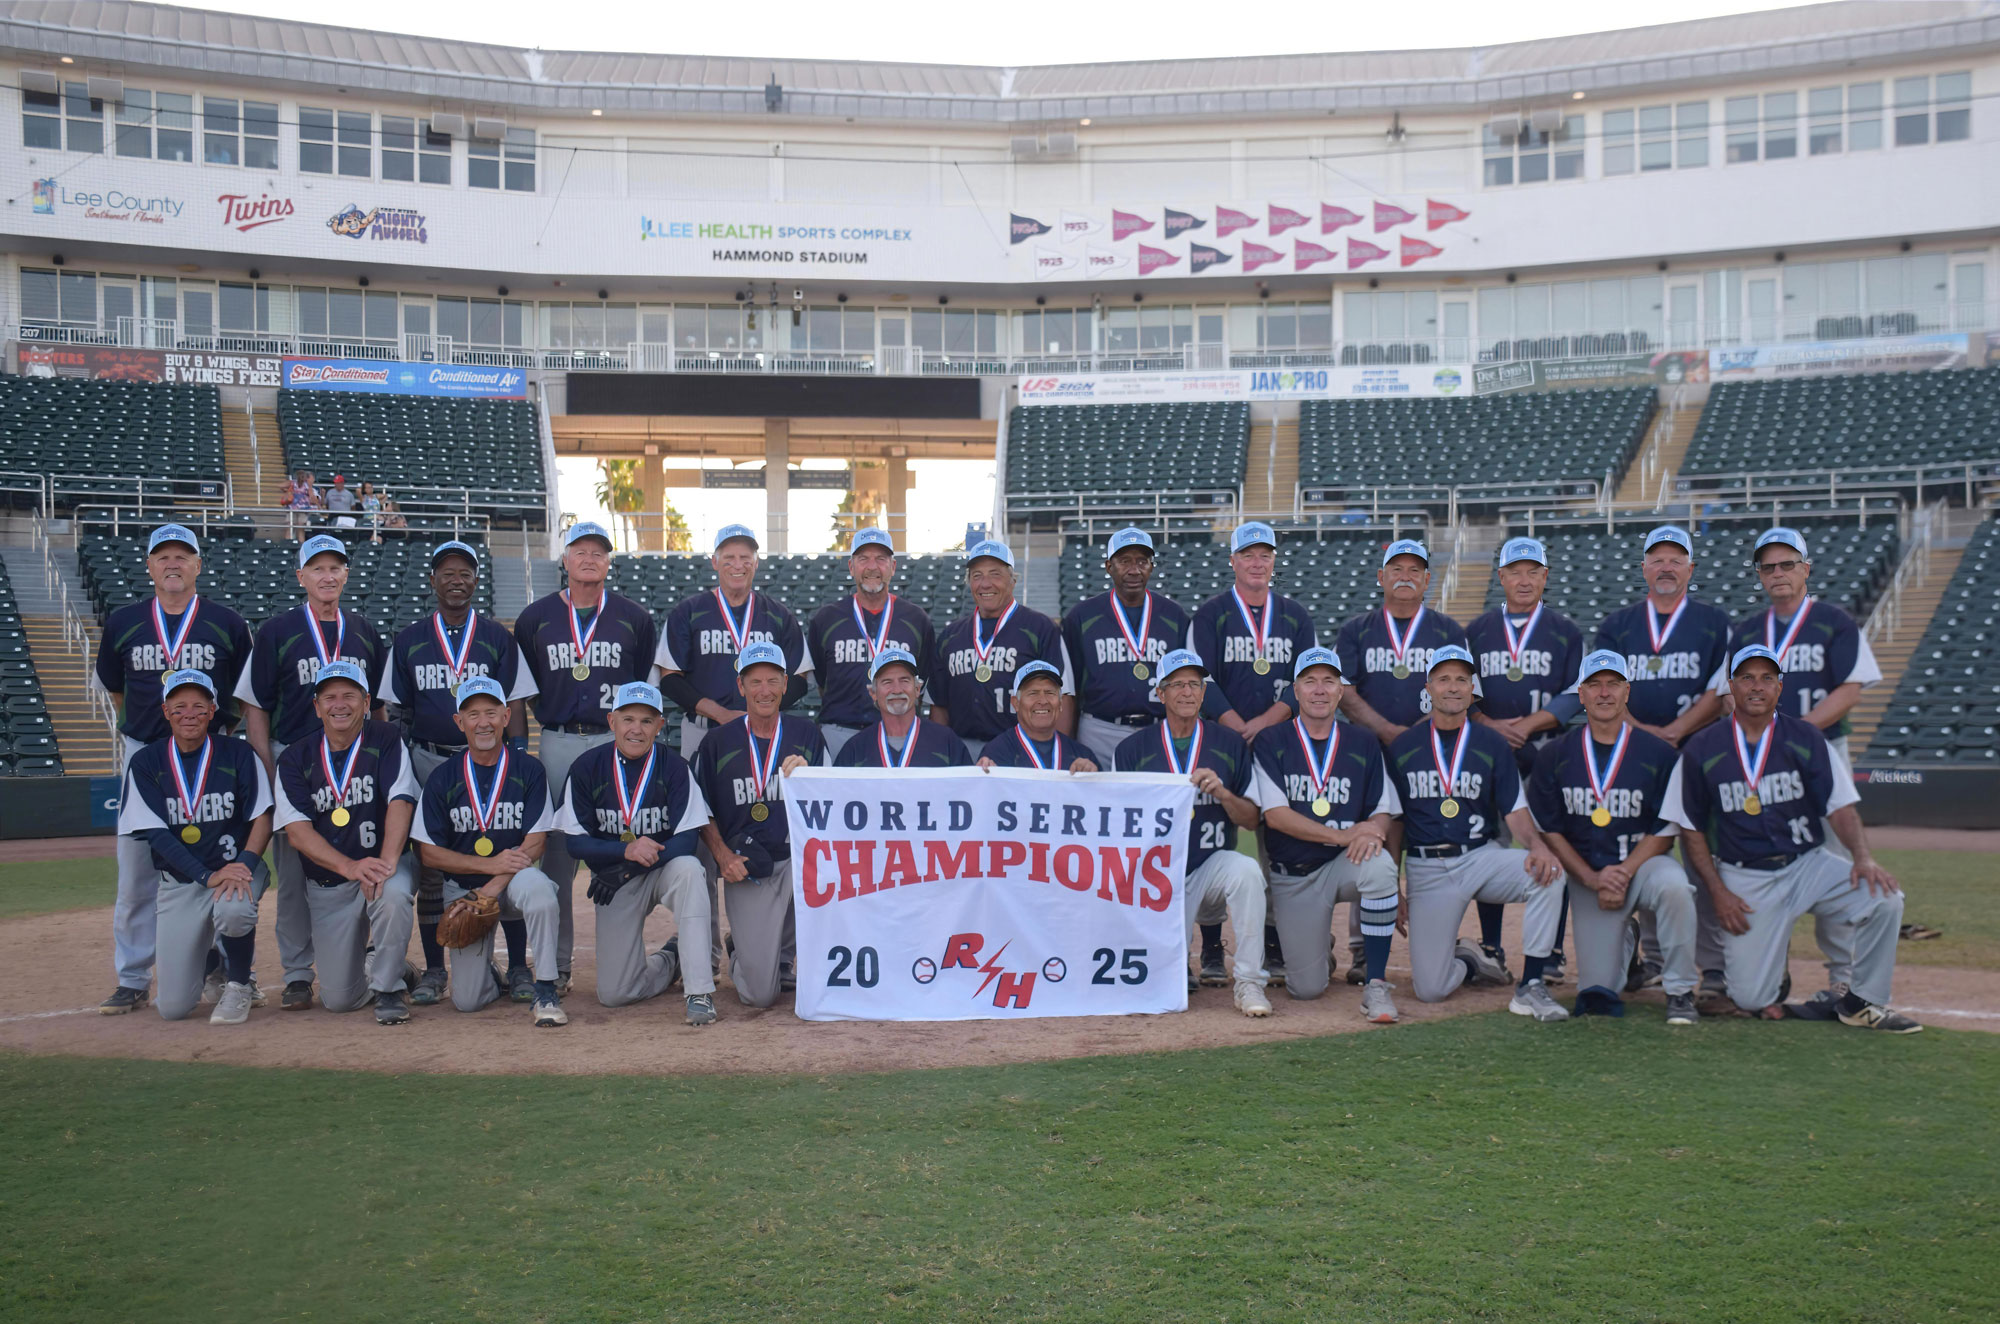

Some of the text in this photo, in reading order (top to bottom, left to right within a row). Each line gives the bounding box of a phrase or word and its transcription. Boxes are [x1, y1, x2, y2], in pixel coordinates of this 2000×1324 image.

[62, 187, 184, 217] Lee County
[217, 193, 295, 225] Twins
[133, 211, 164, 224] Florida
[375, 212, 426, 230] MIGHTY
[371, 225, 428, 244] MUSSELS
[658, 222, 912, 241] LEE HEALTH SPORTS COMPLEX
[712, 250, 868, 264] HAMMOND STADIUM
[21, 328, 40, 338] 207
[165, 353, 191, 367] BUY
[194, 355, 203, 367] 6
[256, 358, 281, 371] GET
[165, 366, 281, 387] 6 WINGS FREE
[290, 364, 389, 382] Stay Conditioned
[428, 368, 521, 388] Conditioned Air
[1293, 370, 1329, 391] PRO
[1022, 377, 1096, 392] US SIGN
[600, 683, 620, 710] 2
[1718, 770, 1805, 813] BRWERS
[796, 799, 1174, 838] WORLD SERIES
[1468, 814, 1486, 840] 2
[359, 820, 377, 849] 6
[218, 834, 238, 861] 3
[802, 836, 1173, 912] CHAMPIONS
[827, 944, 880, 988] 20
[1091, 948, 1149, 985] 25
